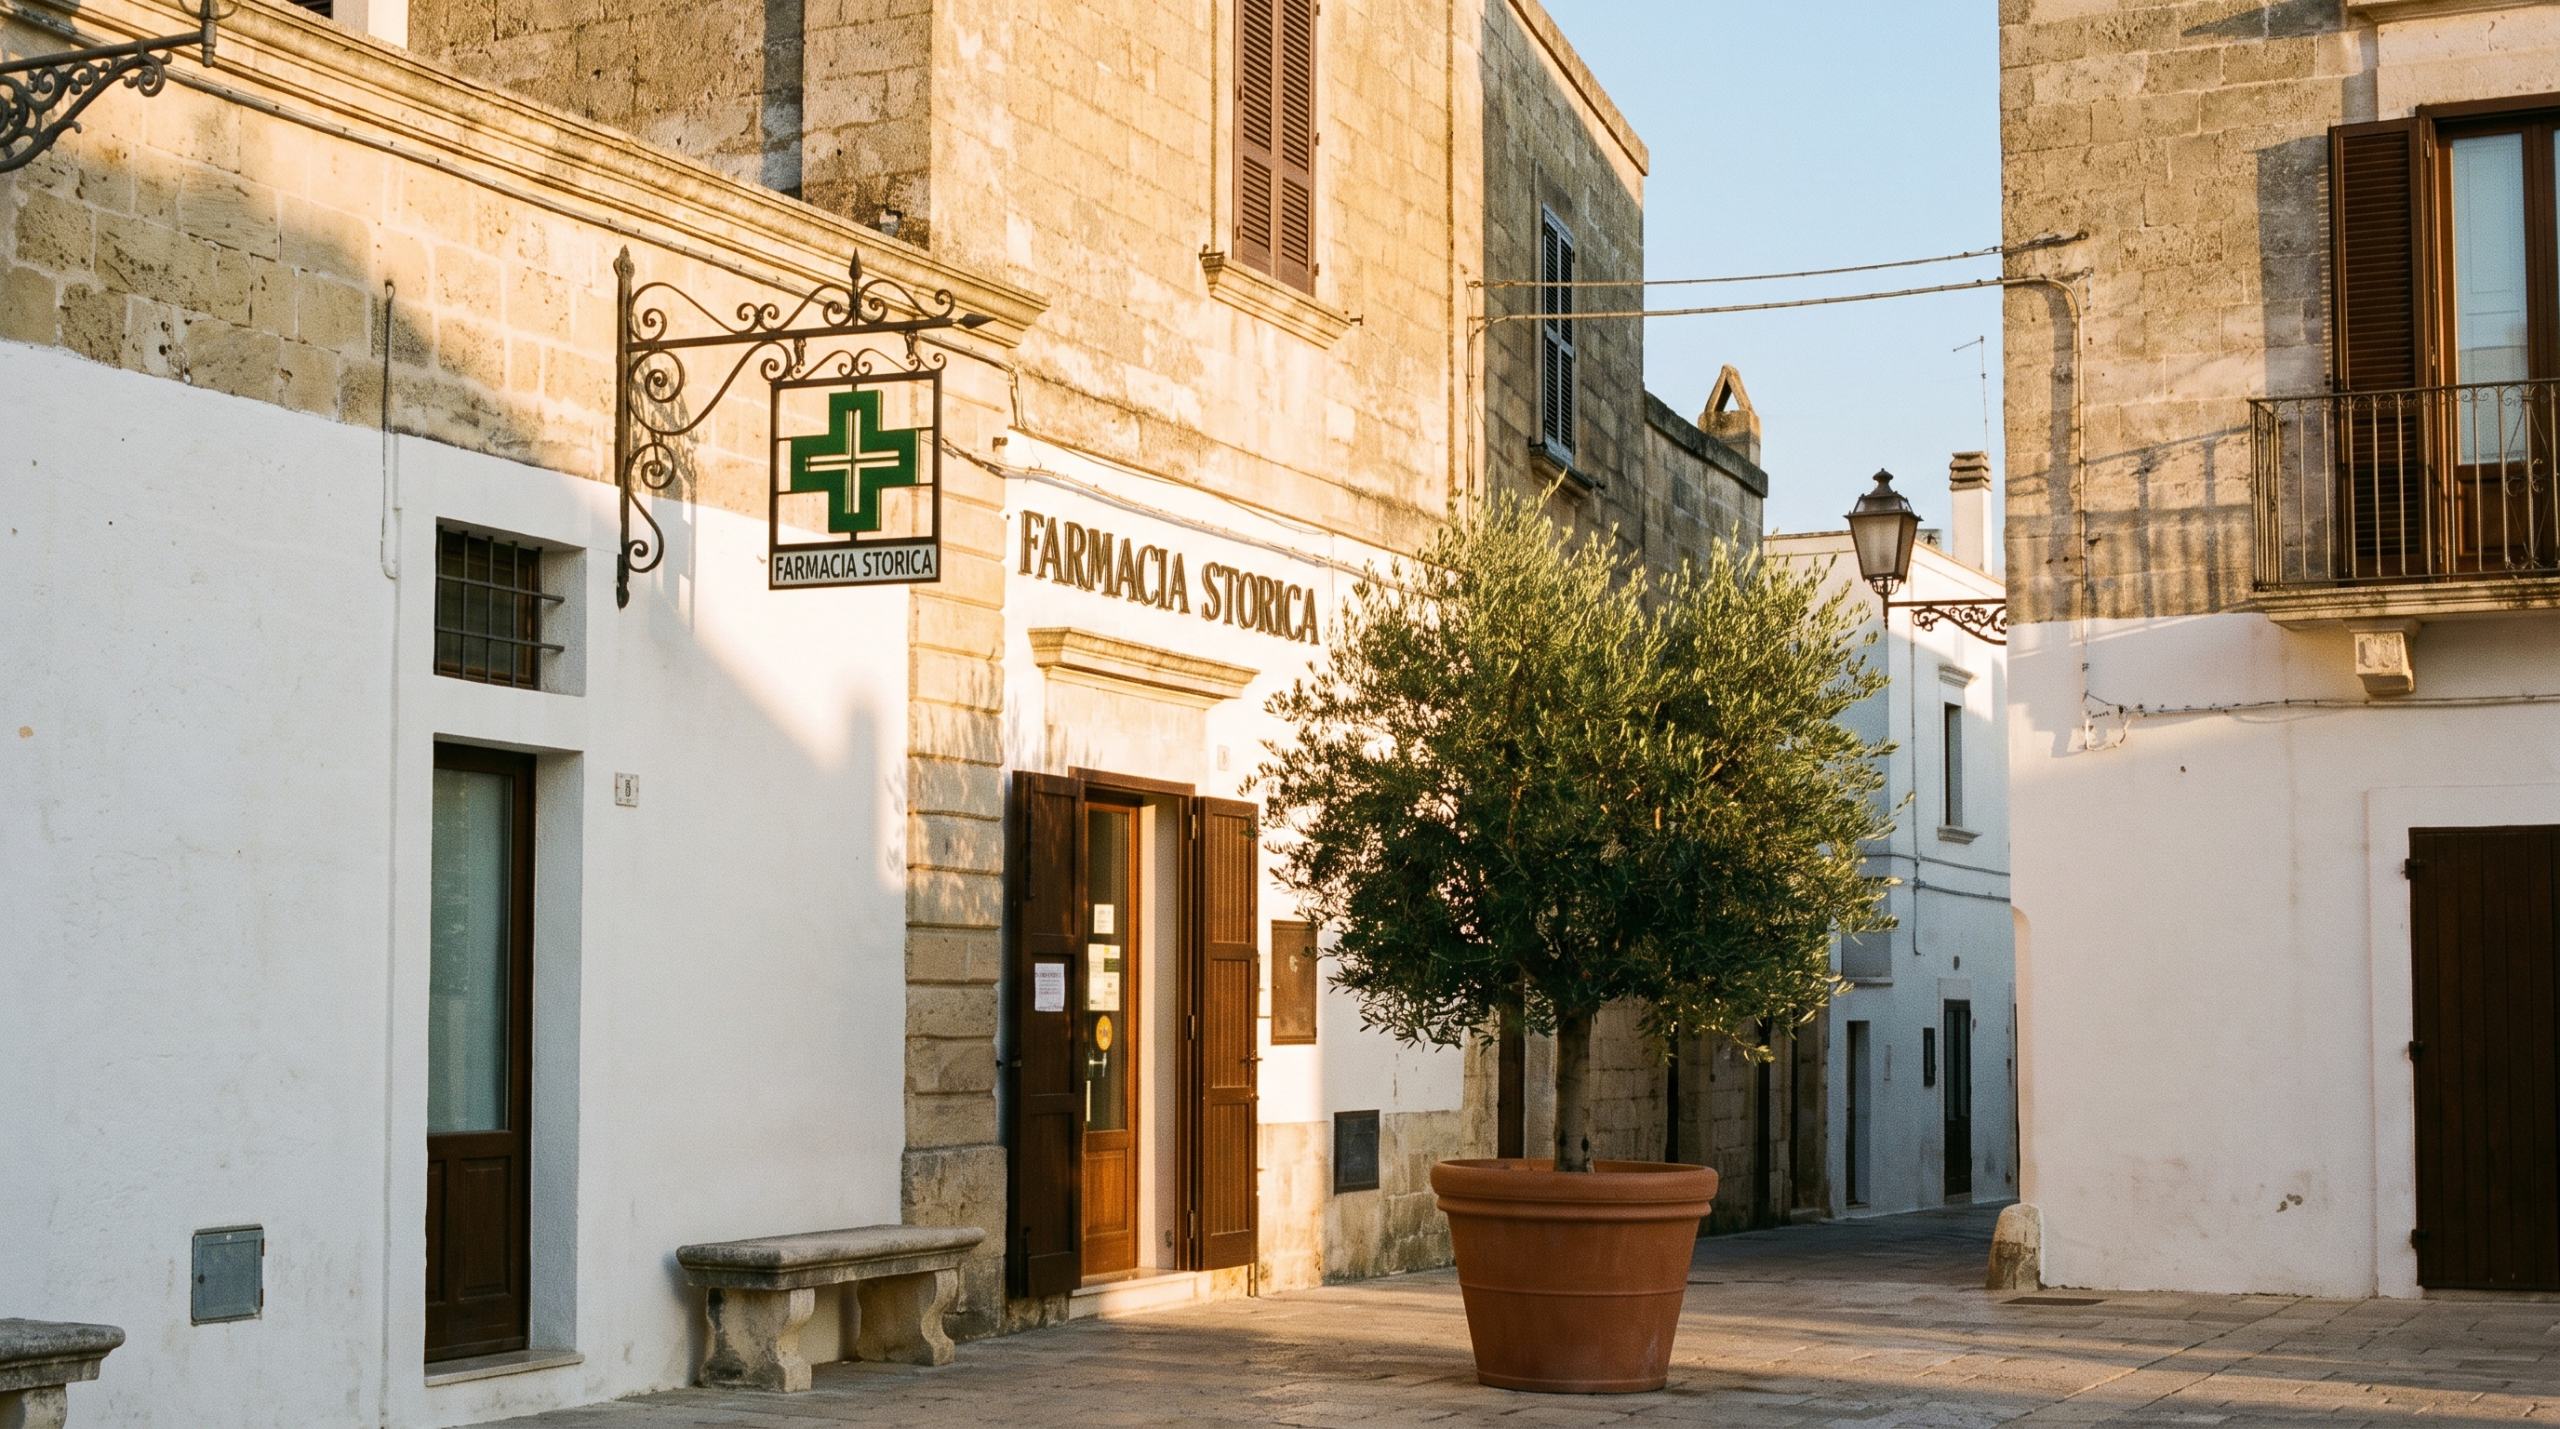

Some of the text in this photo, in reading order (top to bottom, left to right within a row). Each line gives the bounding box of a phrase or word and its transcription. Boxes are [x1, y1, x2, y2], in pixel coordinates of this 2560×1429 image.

[775, 549, 933, 581] FARMACIA STORICA
[1017, 509, 1320, 646] FARMACIA STORICA
